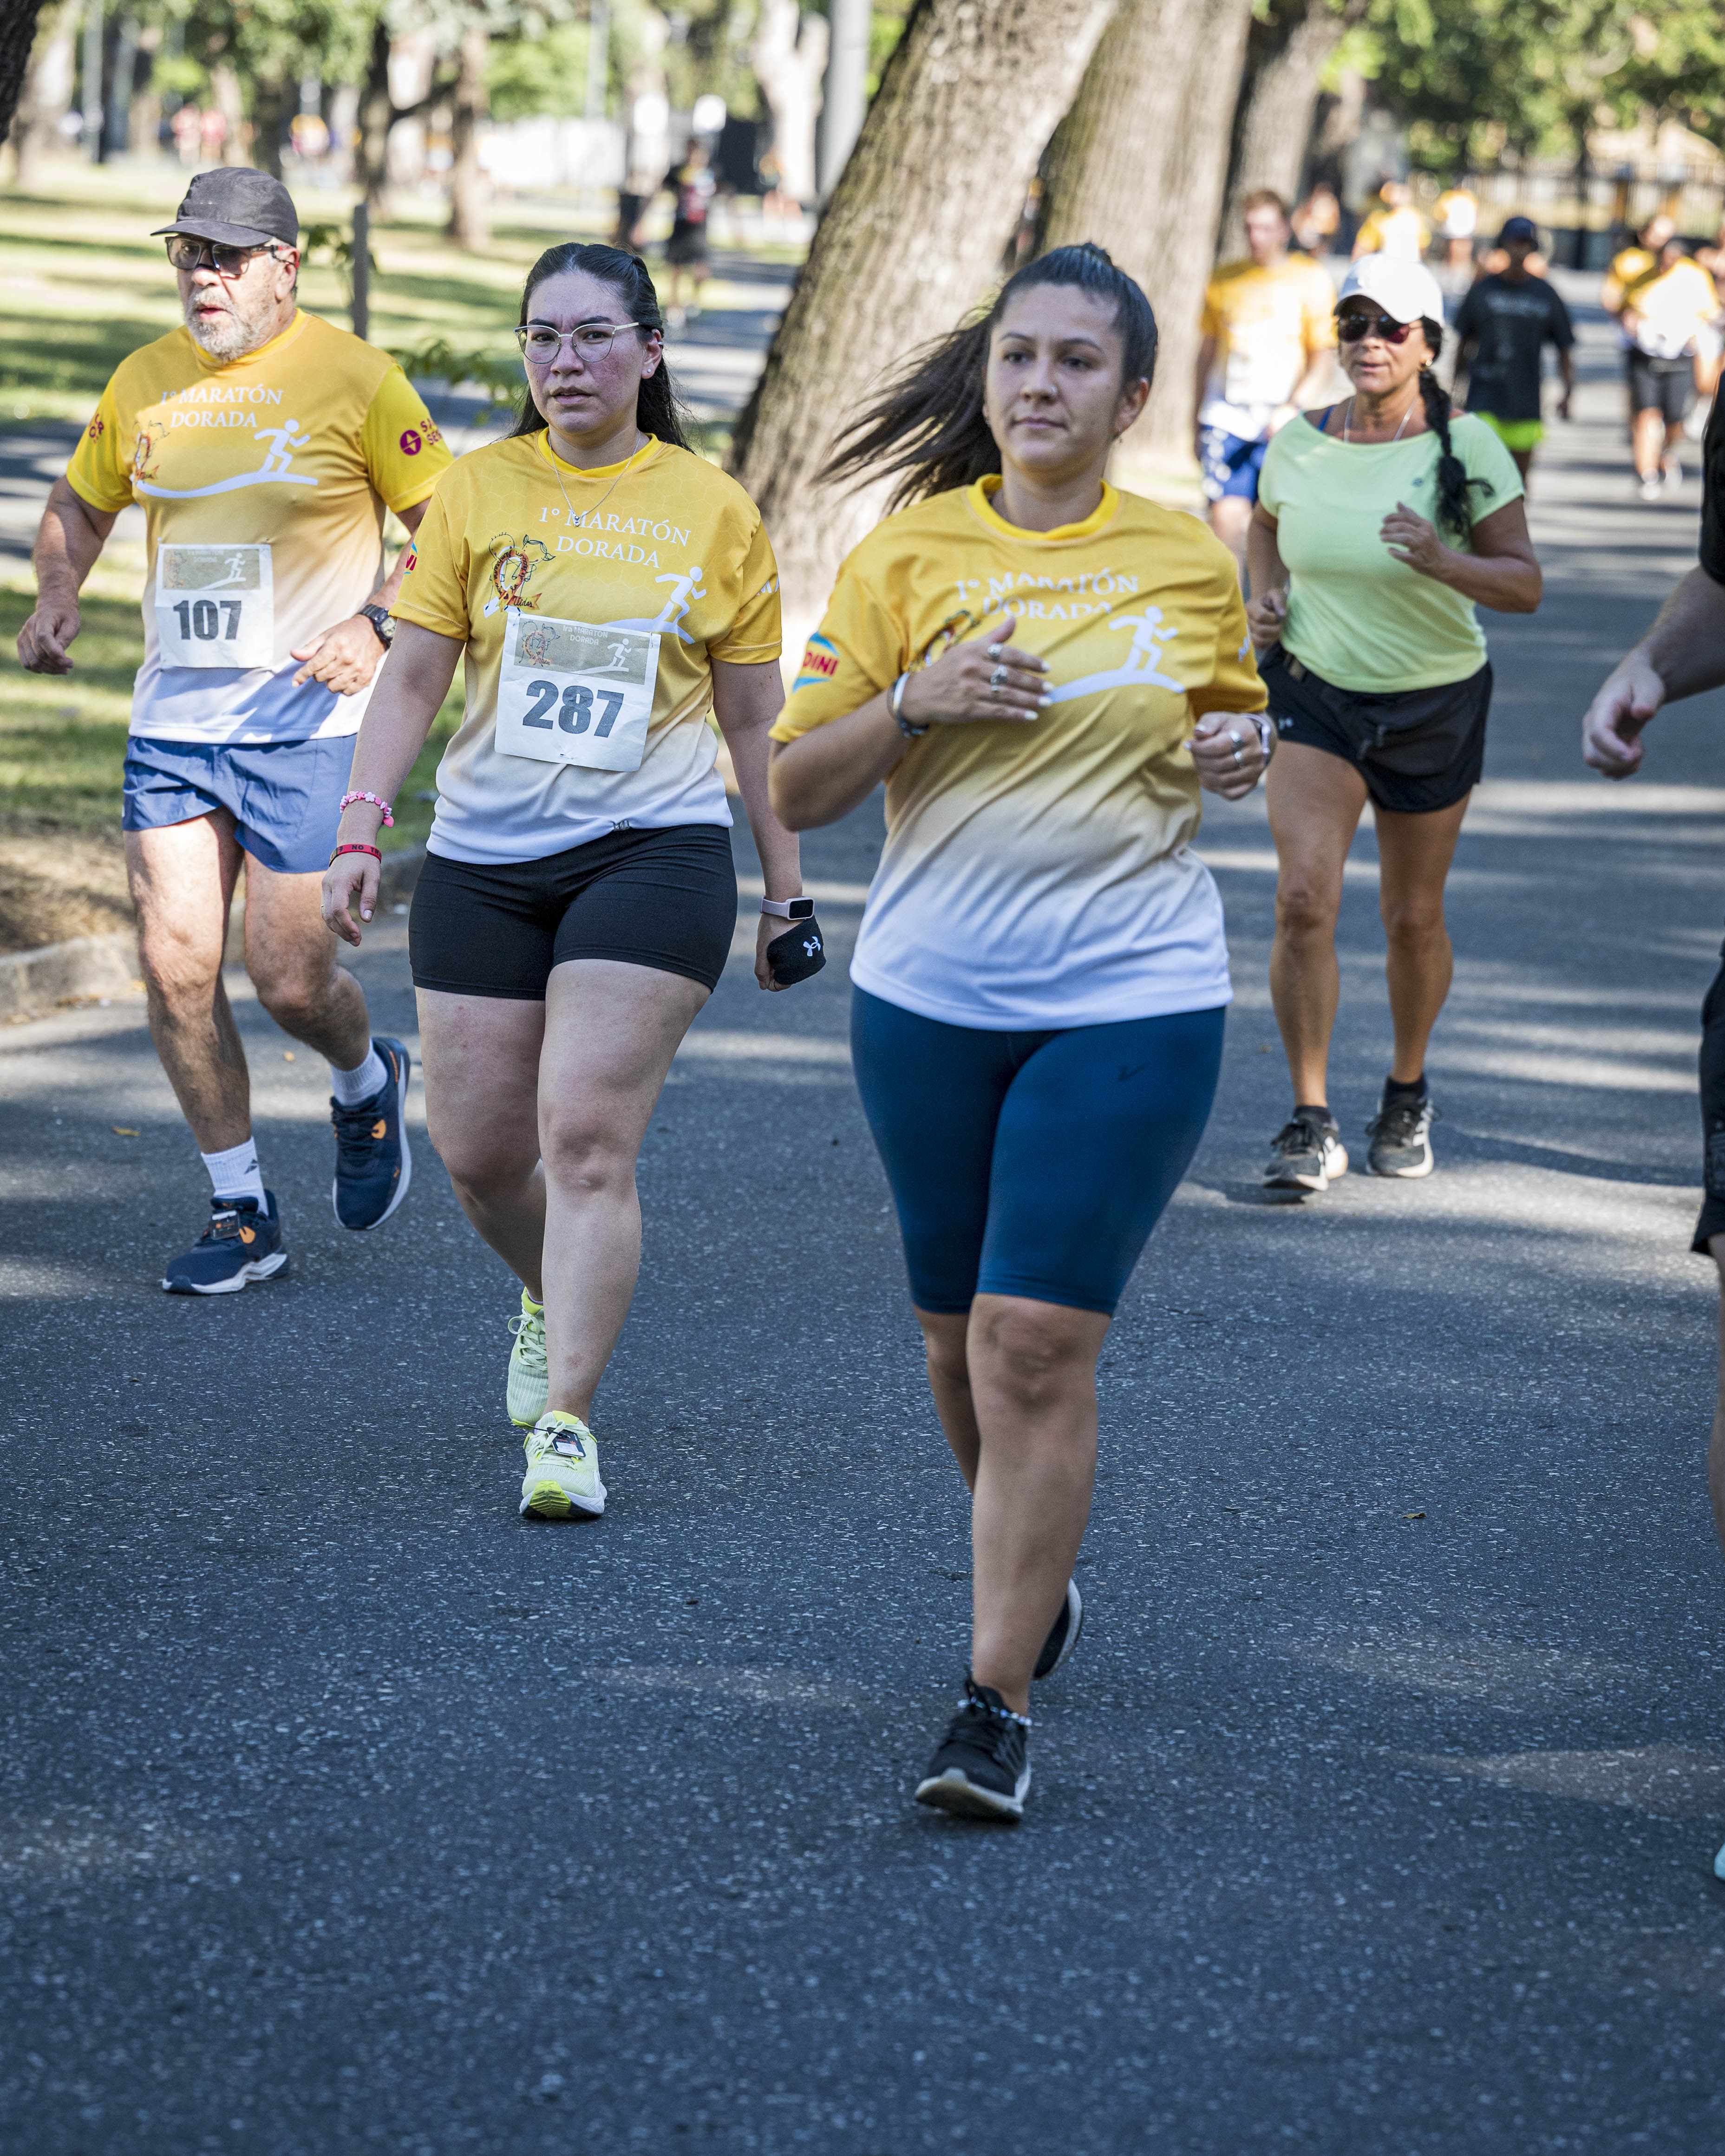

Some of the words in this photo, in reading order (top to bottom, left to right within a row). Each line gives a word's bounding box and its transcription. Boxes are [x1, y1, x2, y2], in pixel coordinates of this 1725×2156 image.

[178, 383, 284, 405] MARATÓN
[170, 410, 258, 428] DORADA
[564, 508, 692, 547] MARATÓN
[555, 535, 660, 568] DORADA
[173, 599, 242, 640] 107
[569, 634, 599, 645] DORADA
[522, 680, 625, 738] 287
